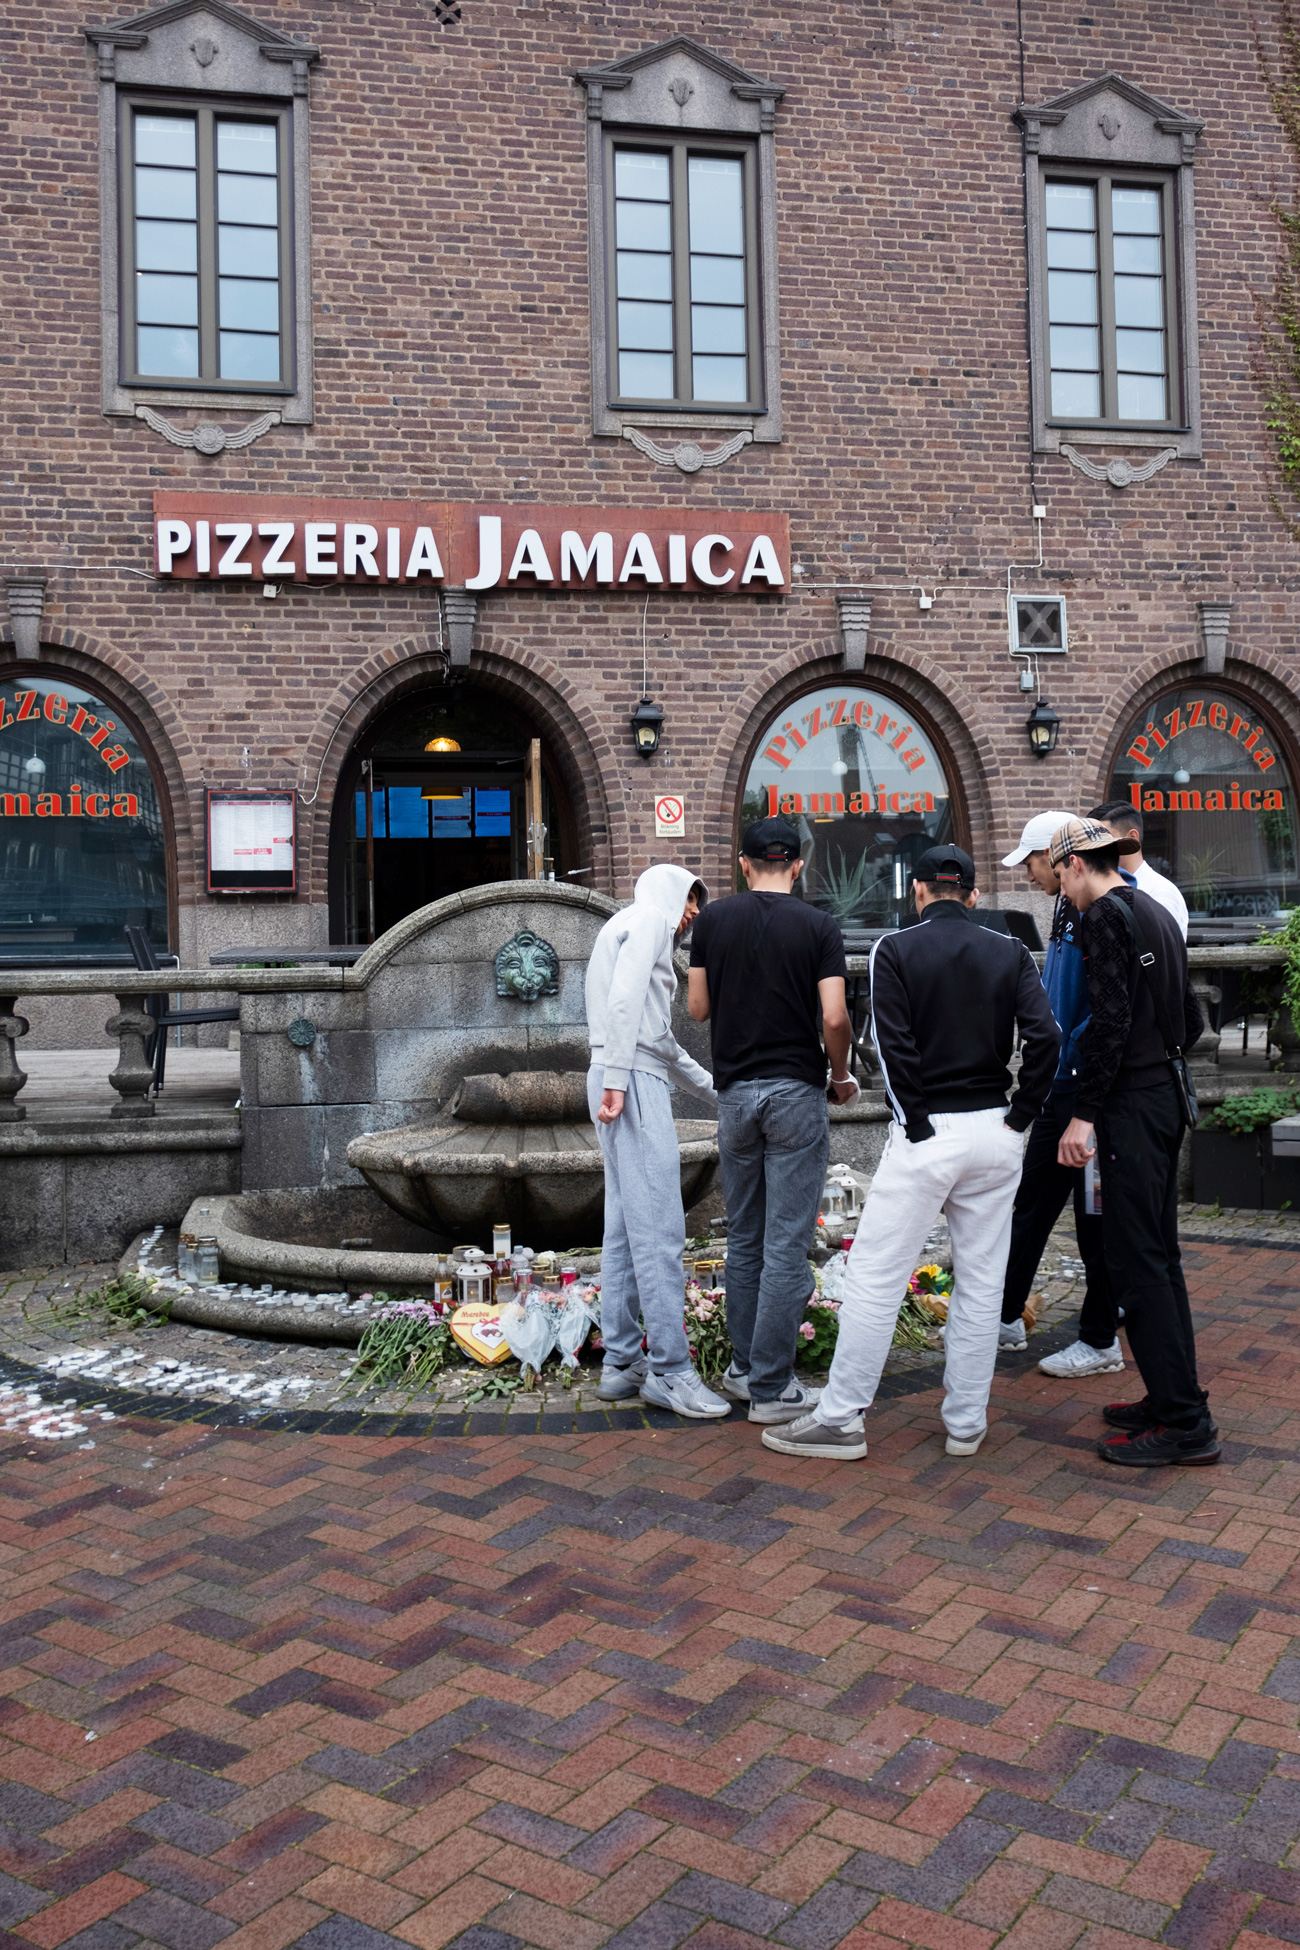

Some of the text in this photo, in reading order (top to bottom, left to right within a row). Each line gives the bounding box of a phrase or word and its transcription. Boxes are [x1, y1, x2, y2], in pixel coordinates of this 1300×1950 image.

[157, 516, 785, 590] PIZZERIA JAMAICA
[763, 699, 926, 771] Pizzeria
[1126, 700, 1276, 773] Pizzeria
[765, 784, 937, 818] Jamaica
[1128, 782, 1286, 812] Jamaica
